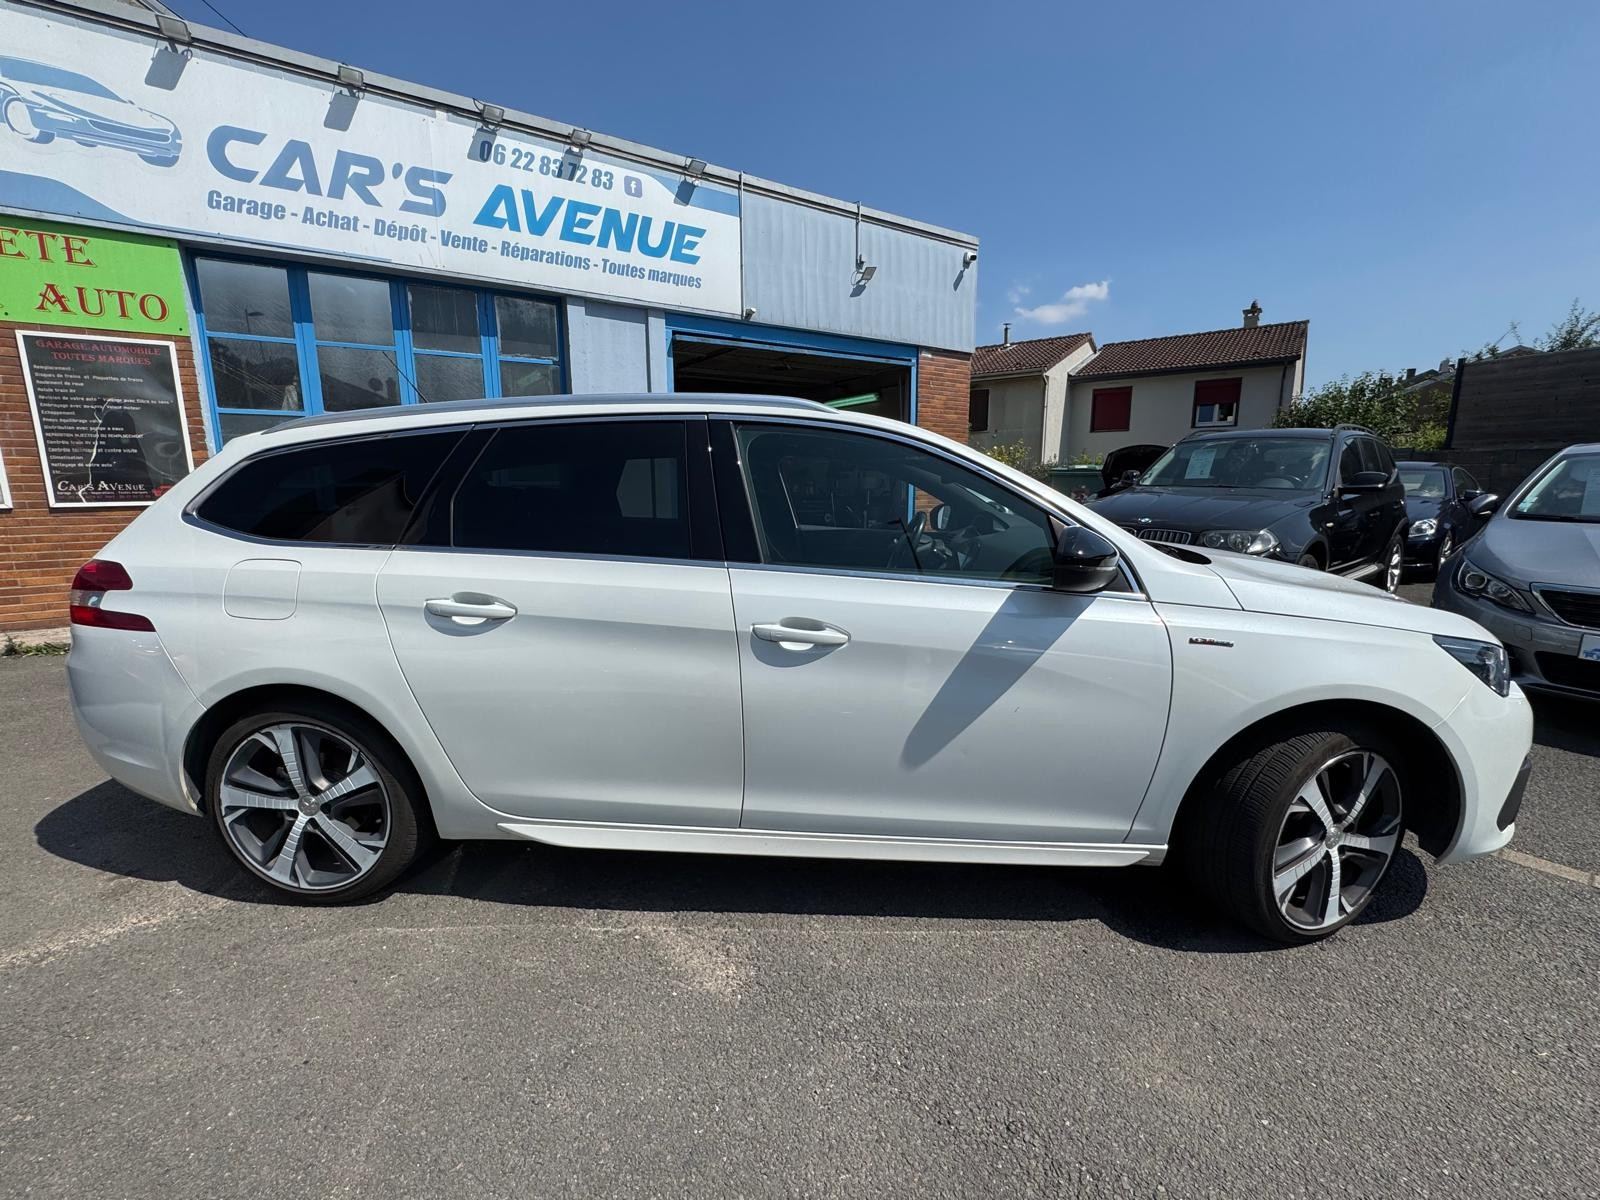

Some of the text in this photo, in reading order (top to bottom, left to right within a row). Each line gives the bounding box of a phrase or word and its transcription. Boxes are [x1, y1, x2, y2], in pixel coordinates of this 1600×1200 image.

[479, 140, 614, 191] 06 22 83 72 83
[206, 124, 708, 266] CAR'S AVENUE
[207, 189, 287, 220] Garage
[301, 206, 361, 233] Achat
[373, 218, 428, 244] Dépôt
[440, 229, 488, 254] Vente
[500, 240, 591, 271] Réparations
[601, 258, 646, 281] Toutes
[647, 269, 703, 289] marques
[36, 283, 170, 322] AUTO
[36, 340, 161, 356] GARAGE AUTOMOBILE
[52, 351, 151, 366] TOUTES MARQUES
